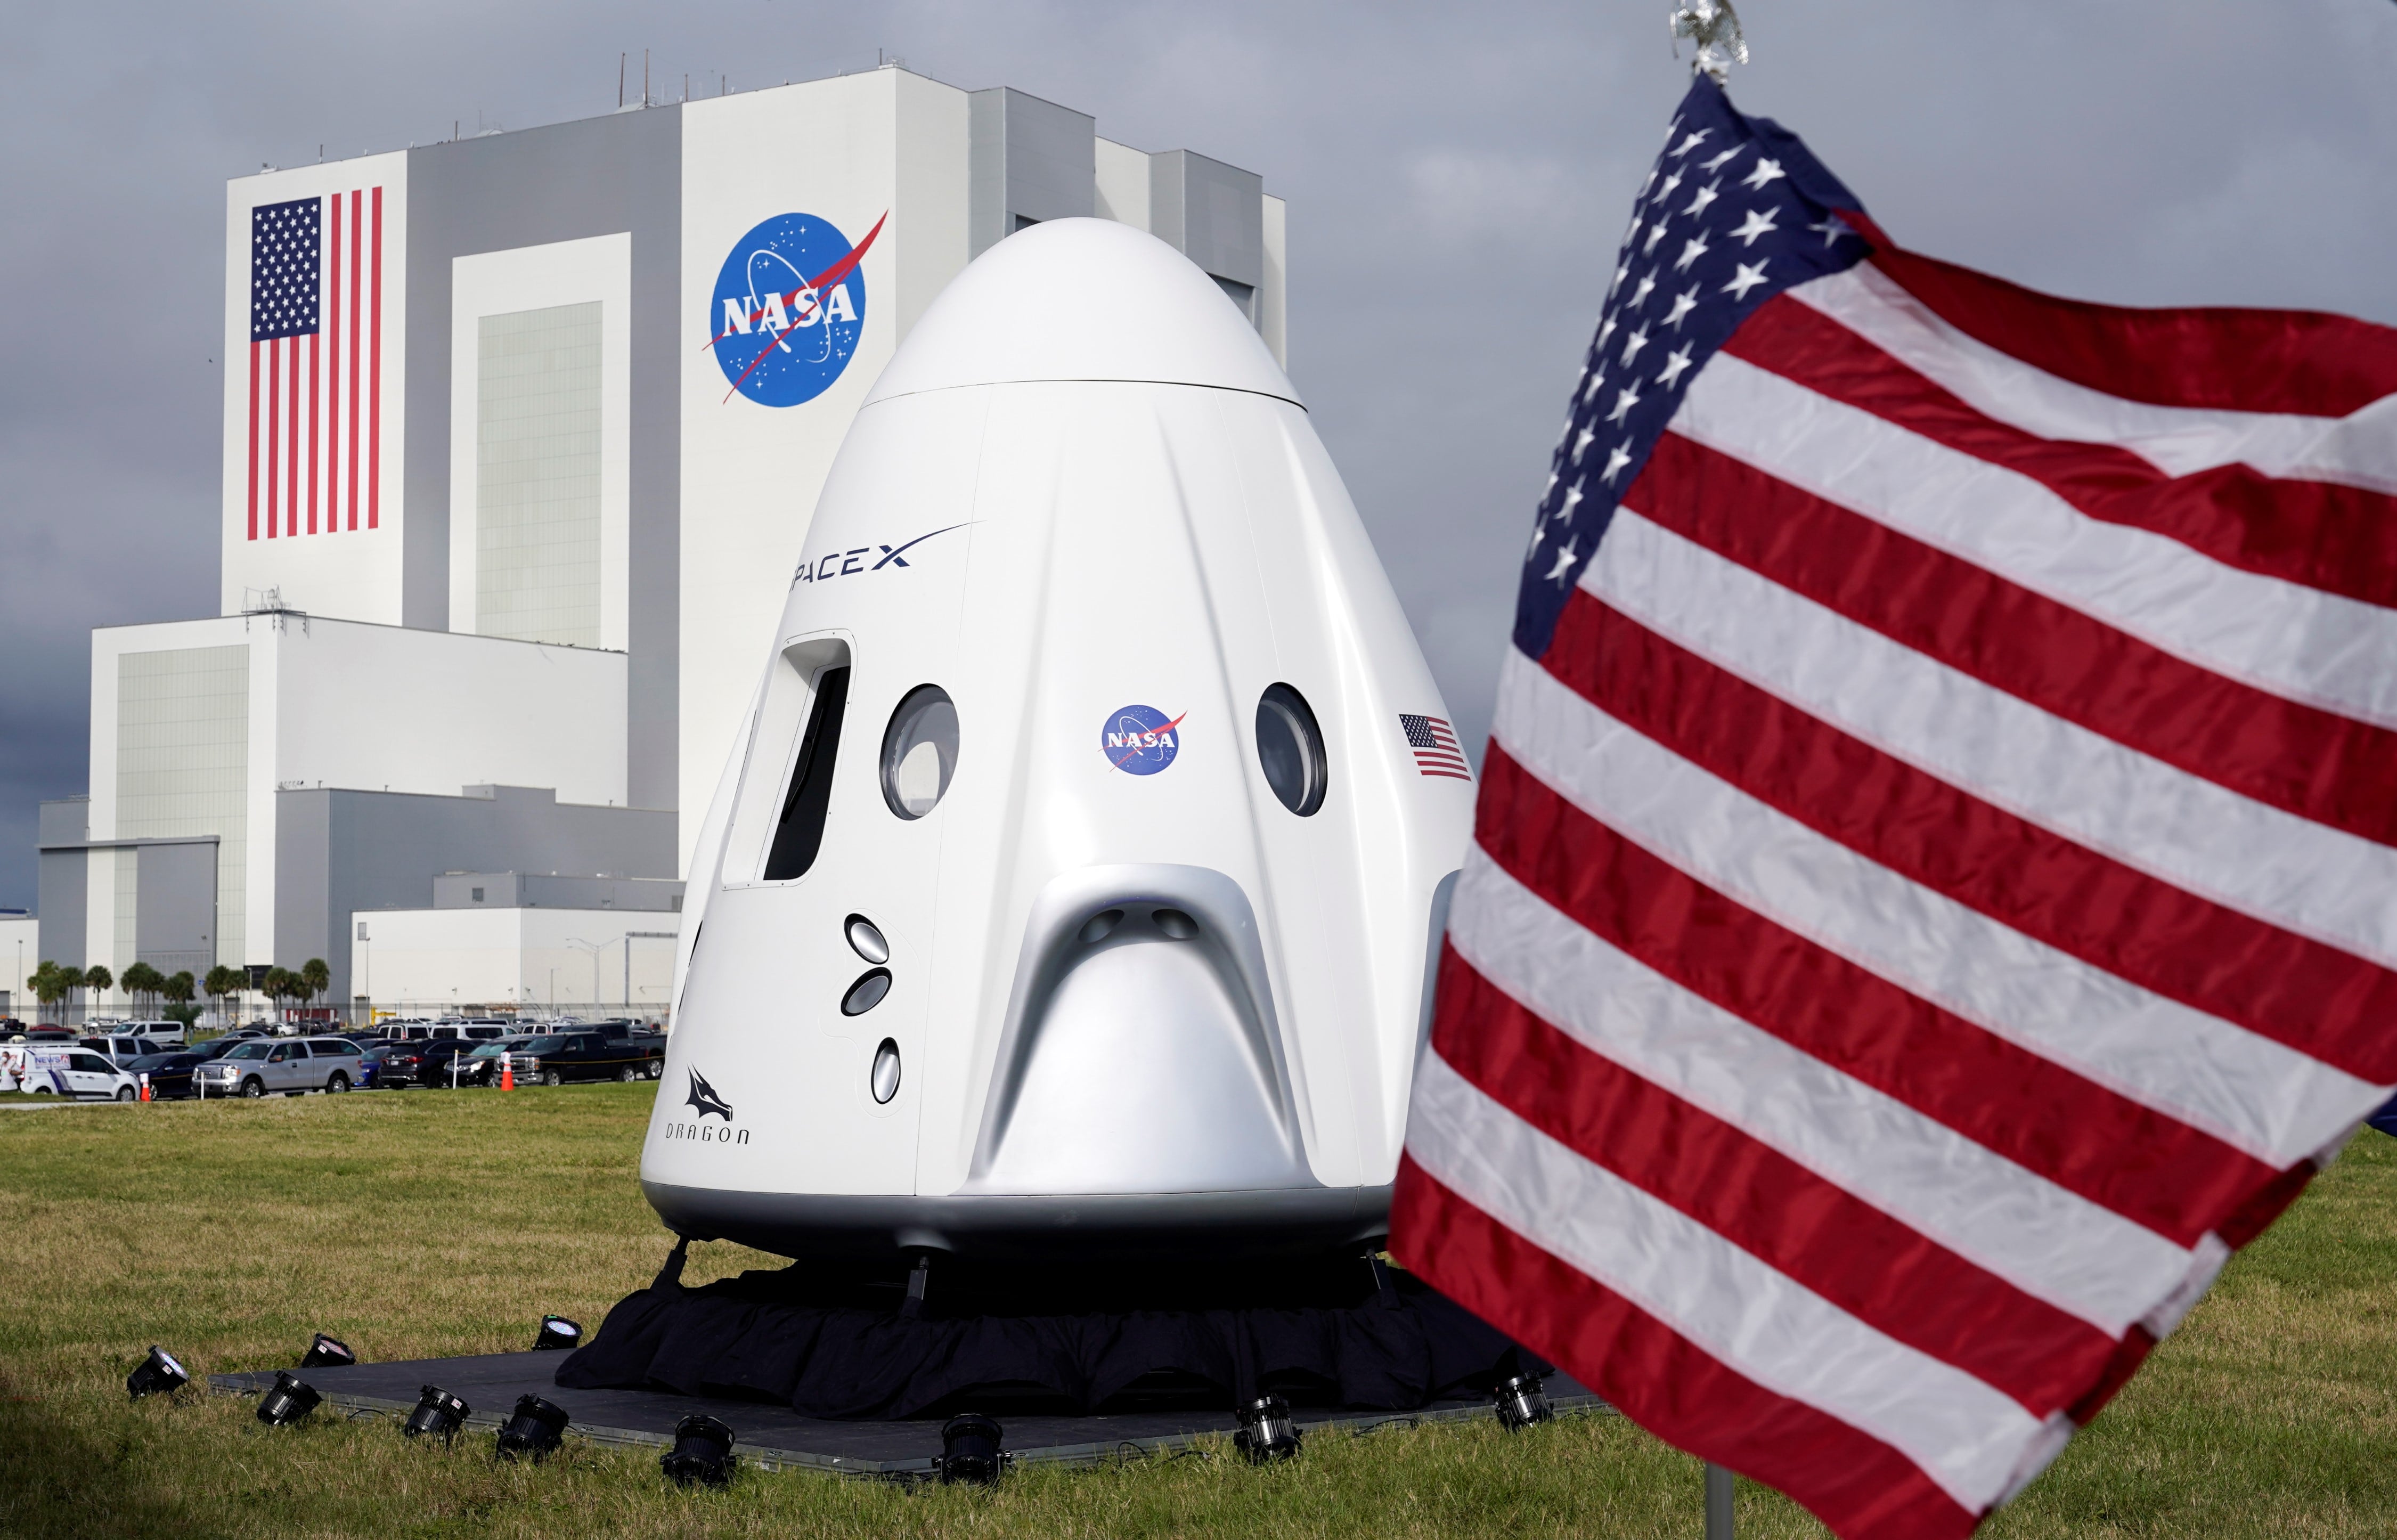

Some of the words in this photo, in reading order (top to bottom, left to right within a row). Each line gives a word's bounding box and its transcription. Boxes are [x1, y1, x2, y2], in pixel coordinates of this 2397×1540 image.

[722, 283, 858, 337] NASA
[1107, 732, 1175, 748] NASA
[666, 1123, 749, 1144] DRAGON
